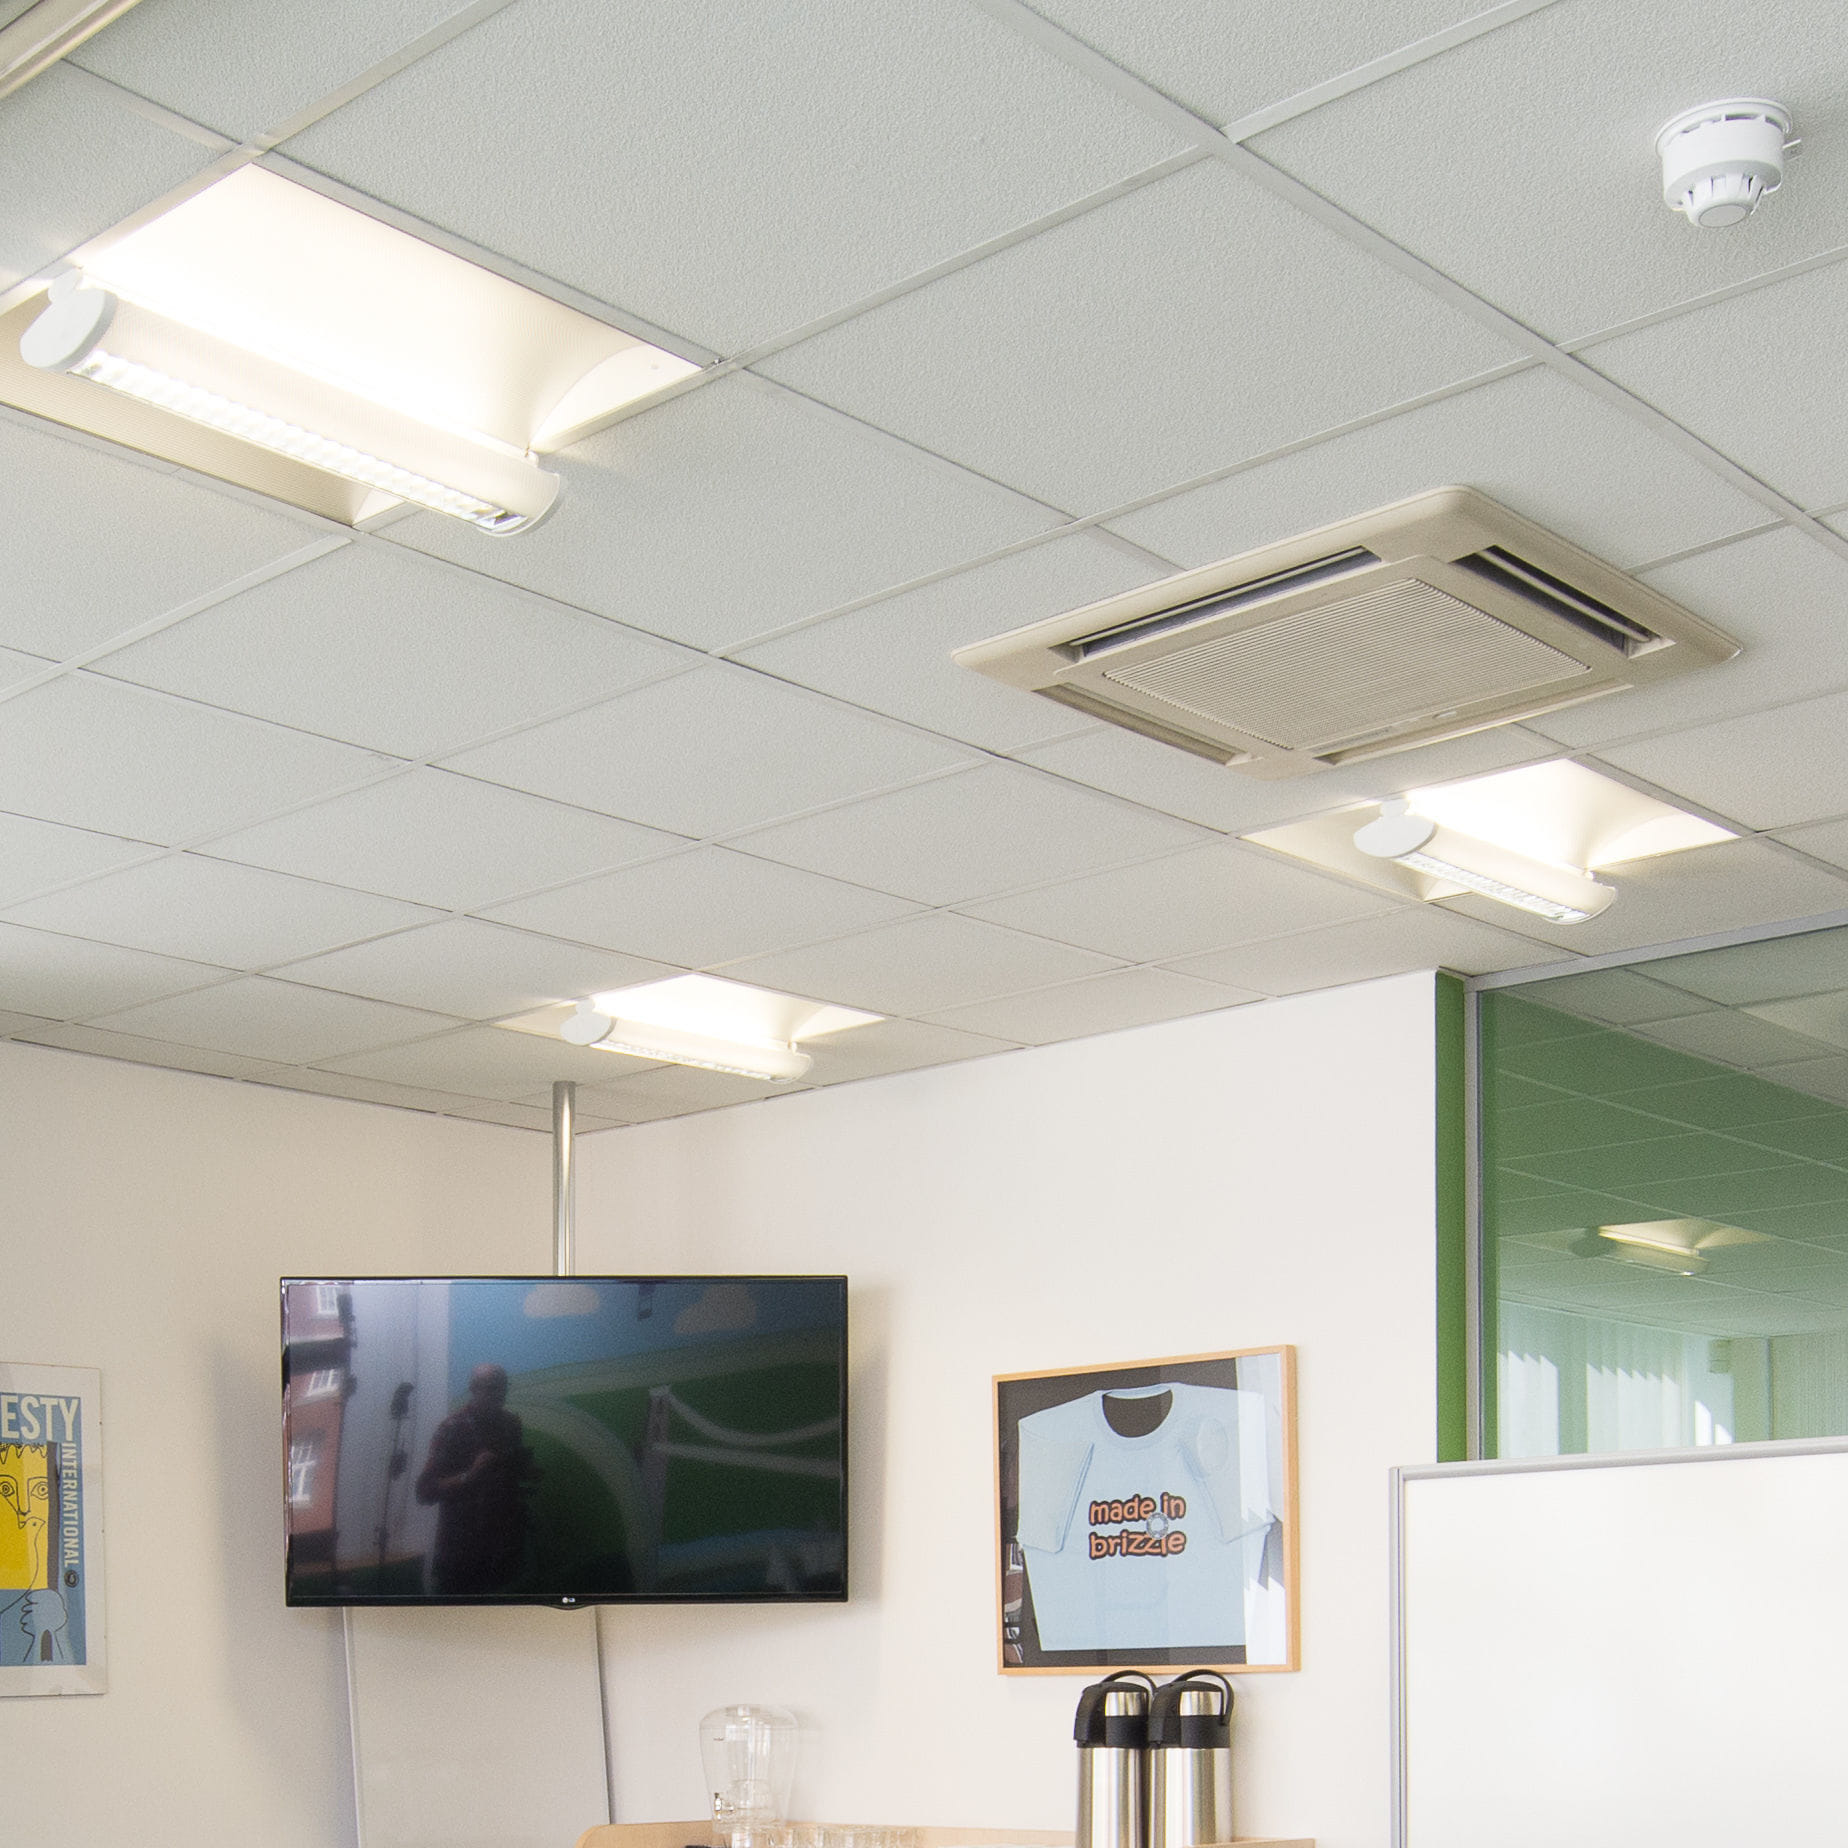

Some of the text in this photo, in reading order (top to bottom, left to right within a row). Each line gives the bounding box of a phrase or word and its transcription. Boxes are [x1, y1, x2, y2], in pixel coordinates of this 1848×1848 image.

[61, 1441, 80, 1568] INTERNATIONAL
[1088, 1492, 1187, 1526] made in
[1088, 1529, 1188, 1560] brizzle
